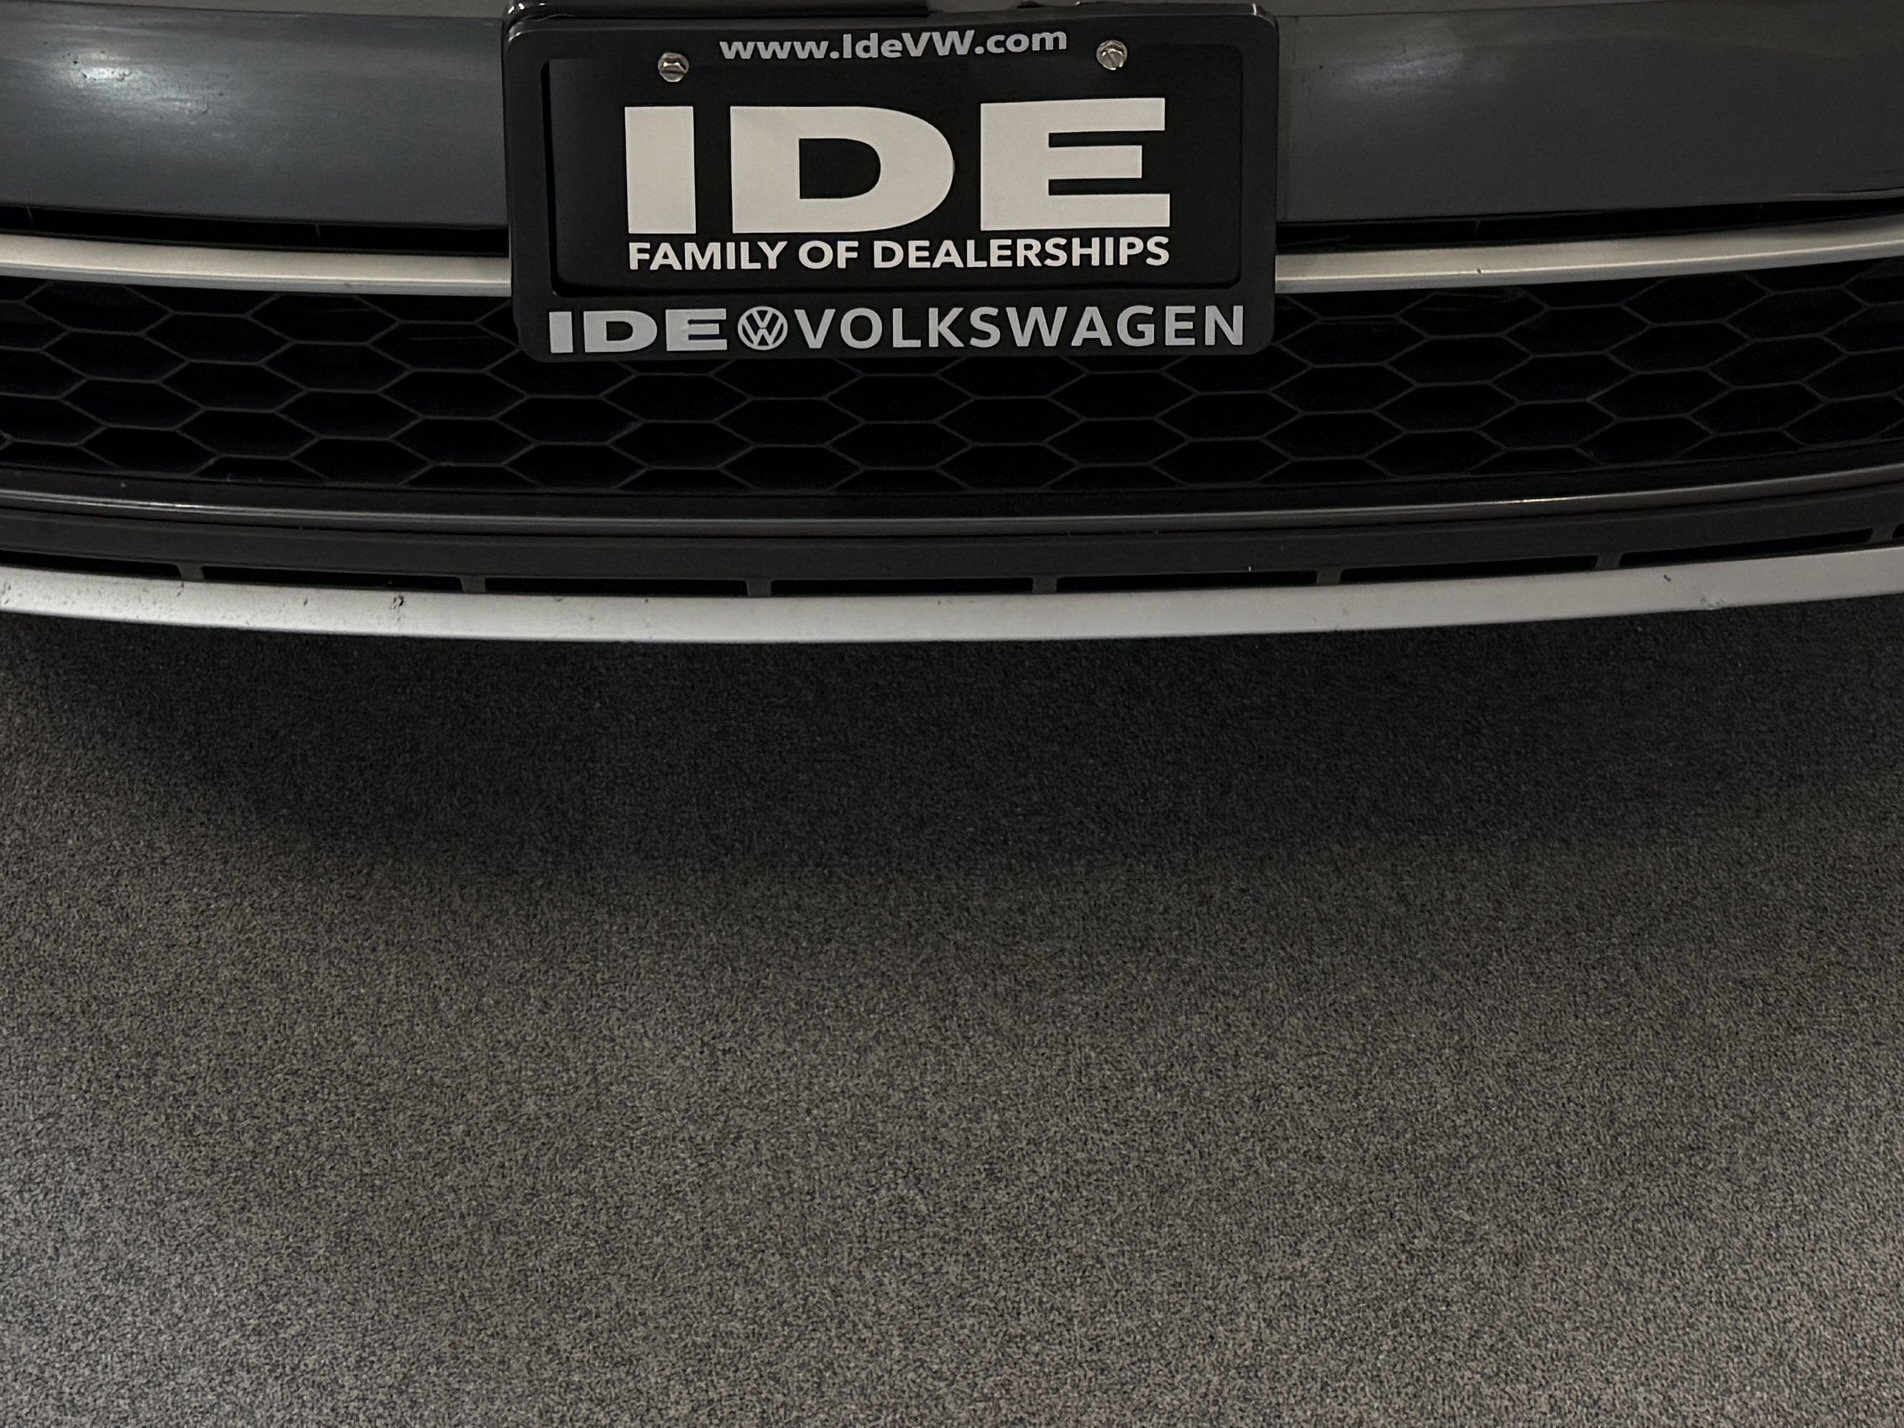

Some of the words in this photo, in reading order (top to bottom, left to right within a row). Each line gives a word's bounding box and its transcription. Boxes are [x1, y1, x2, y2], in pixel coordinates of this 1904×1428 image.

[719, 29, 1067, 61] www.IdeVW.com
[624, 97, 1171, 235] IDE
[628, 240, 788, 271] FAMILY
[798, 240, 859, 270] OF
[873, 235, 1170, 269] DEALERSHIPS
[548, 308, 728, 354] IDE
[793, 304, 1244, 350] VOLKSWAGEN
